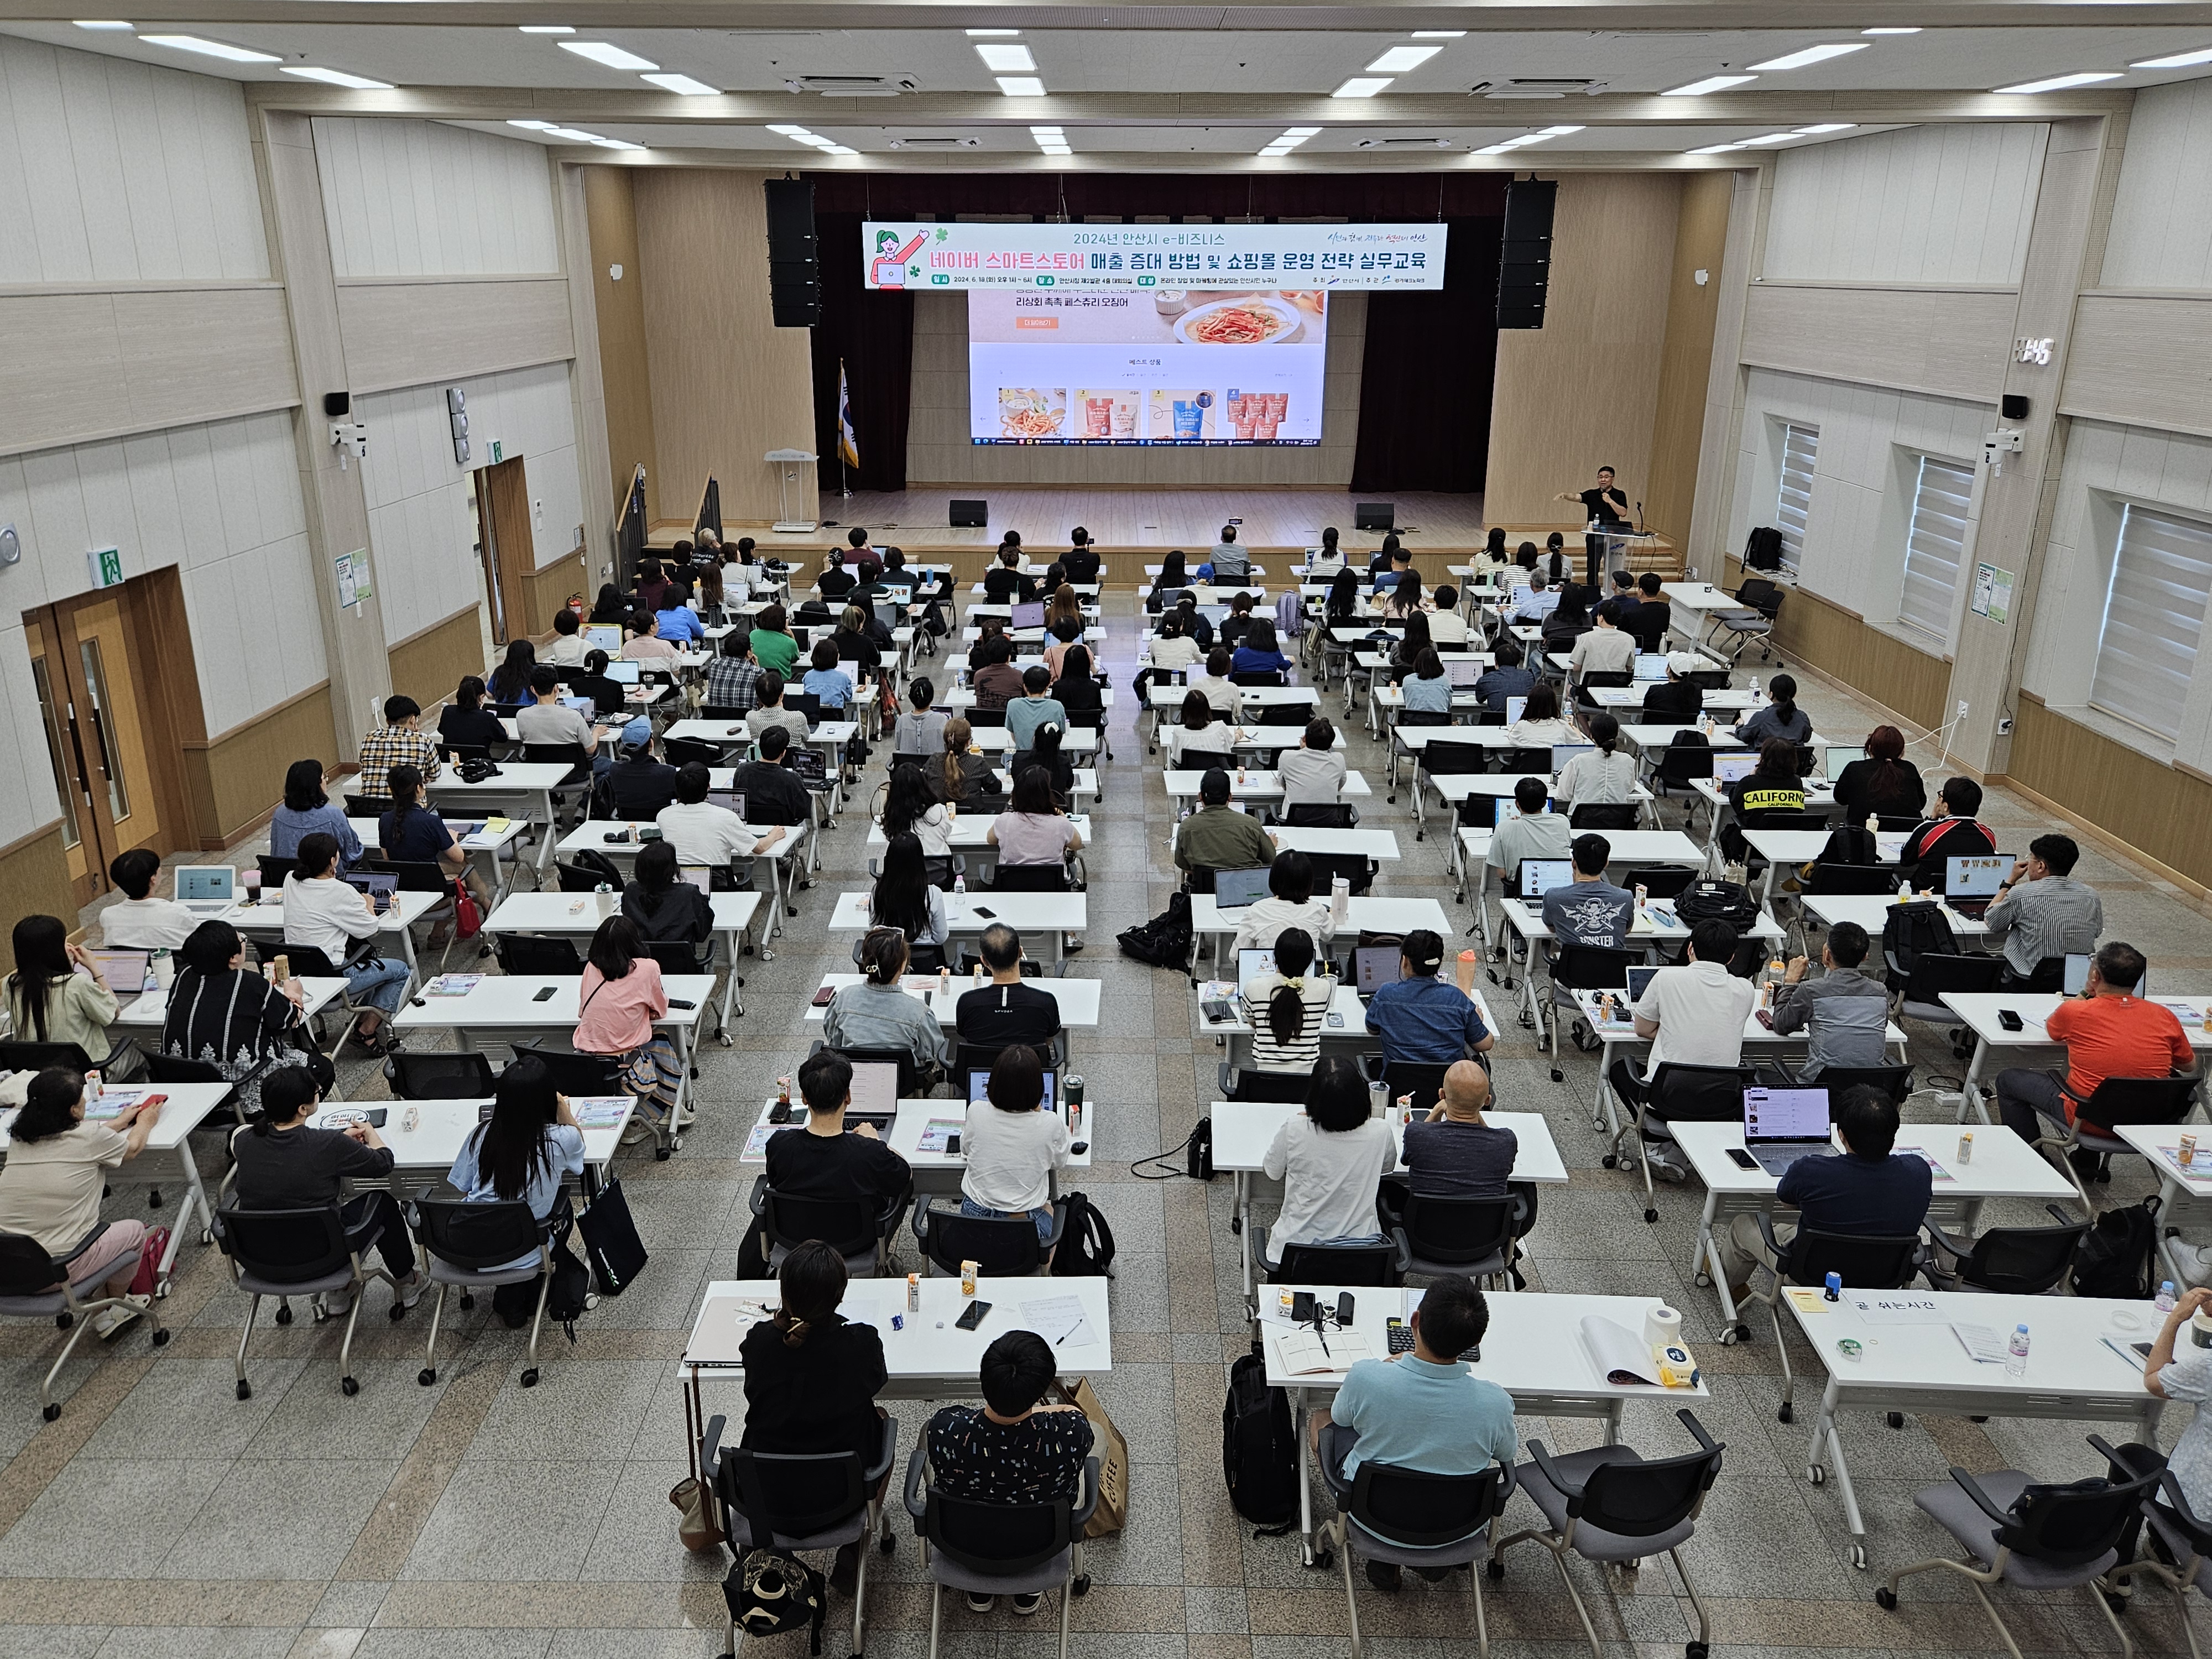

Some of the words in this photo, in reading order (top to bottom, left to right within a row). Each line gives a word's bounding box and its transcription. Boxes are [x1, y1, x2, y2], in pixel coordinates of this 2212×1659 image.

[1073, 233, 1118, 245] 2024년
[1123, 233, 1157, 245] 안산시
[1162, 233, 1225, 245] e-비즈니스
[930, 252, 978, 269] 네이버
[985, 252, 1084, 269] 스마트스토어
[1091, 252, 1124, 269] 매출
[1130, 253, 1162, 269] 증대
[1168, 252, 1200, 269] 방법
[1207, 254, 1220, 269] 및
[1227, 253, 1276, 270] 쇼핑몰
[1282, 252, 1314, 269] 운영
[1321, 252, 1355, 269] 전략
[1360, 252, 1427, 269] 실무교육
[1016, 297, 1042, 307] 리상회
[1045, 297, 1062, 307] 촉촉
[1065, 297, 1100, 307] 페스츄리
[1101, 298, 1128, 307] 오징어
[1855, 1301, 1870, 1310] 곧
[1878, 1301, 1937, 1310] 쉬는시간
[1106, 1458, 1118, 1503] COFFEE
